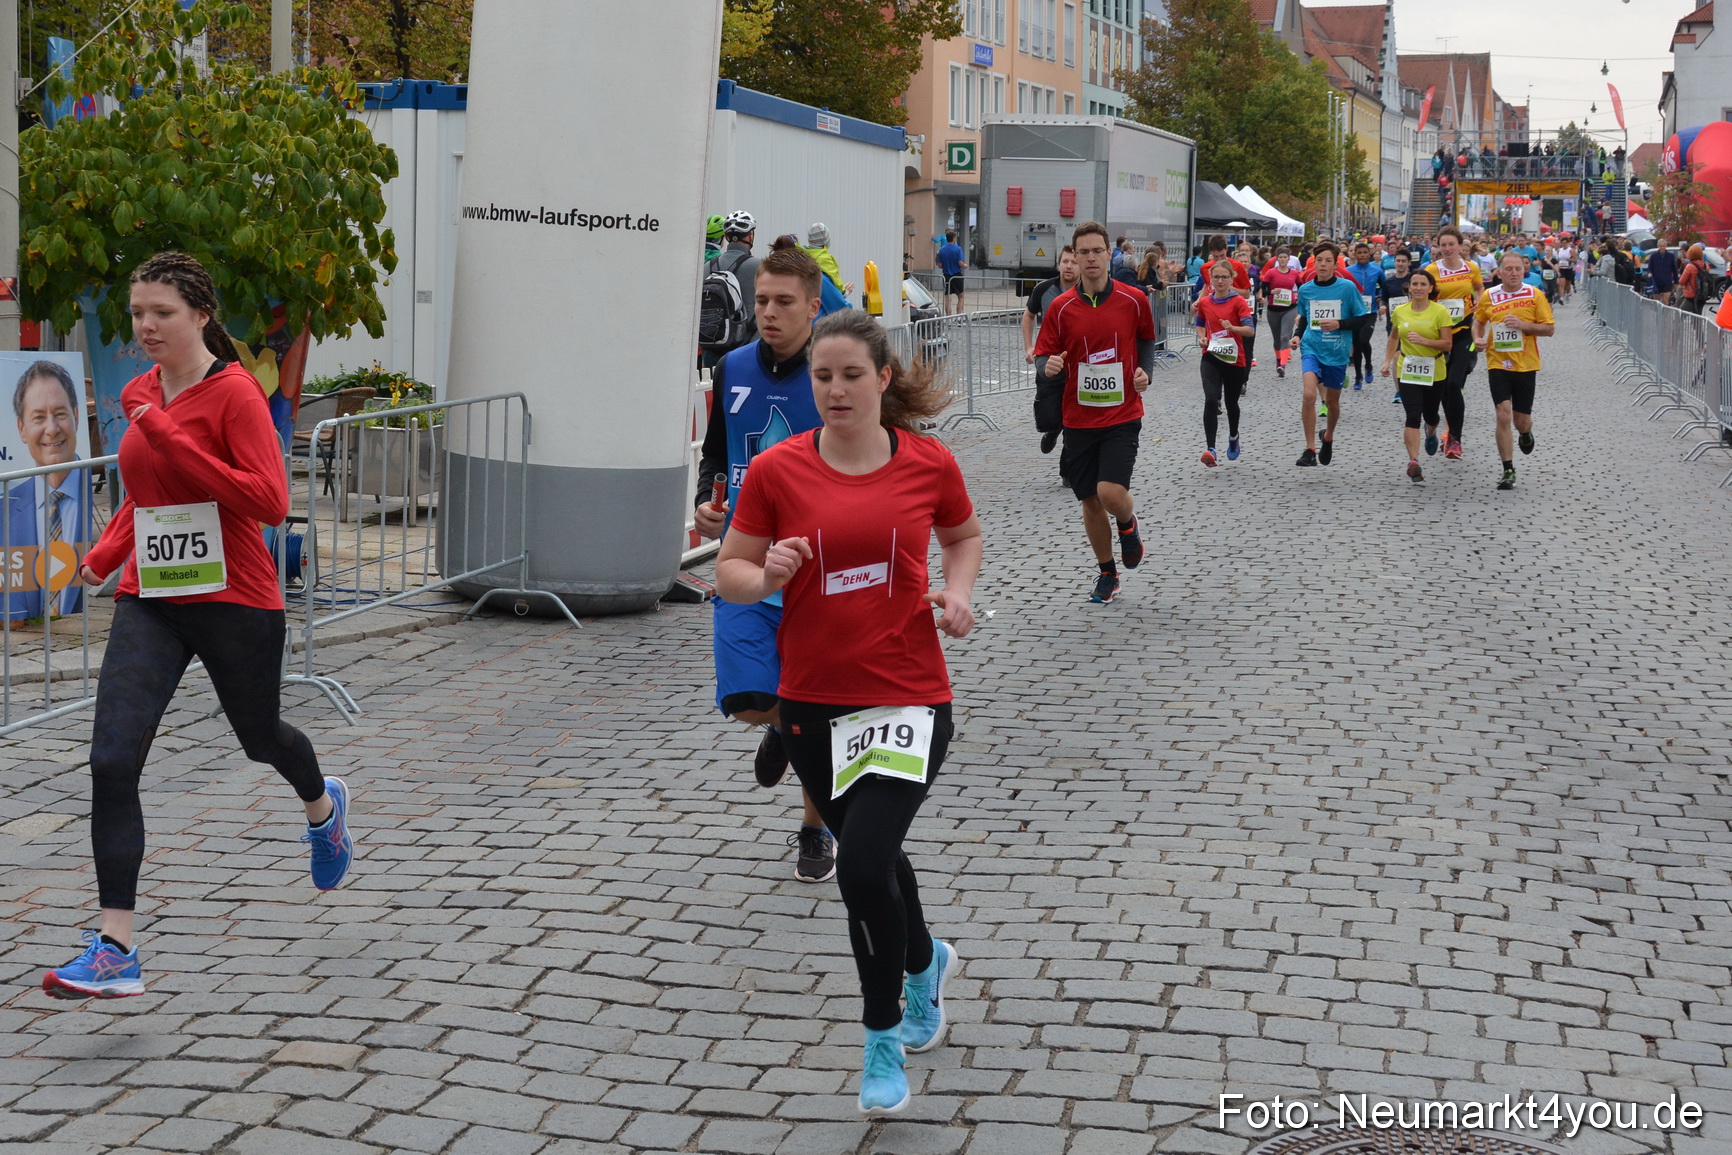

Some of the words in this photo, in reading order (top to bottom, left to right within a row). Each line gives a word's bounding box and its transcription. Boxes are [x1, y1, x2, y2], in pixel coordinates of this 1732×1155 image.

[952, 147, 971, 167] D
[1506, 183, 1533, 193] ZIEL
[462, 203, 660, 232] www.bmw-laufsport.de
[1314, 309, 1335, 318] 5271
[1491, 304, 1510, 315] MAX
[1496, 331, 1518, 340] 5176
[1212, 345, 1234, 355] 5055
[1406, 364, 1430, 374] 5115
[1084, 376, 1116, 390] 5036
[729, 386, 752, 414] 7
[147, 531, 208, 562] 5075
[160, 569, 199, 581] Michaela
[842, 572, 870, 586] DEHN
[846, 723, 914, 762] 5019
[858, 751, 890, 769] Nadine
